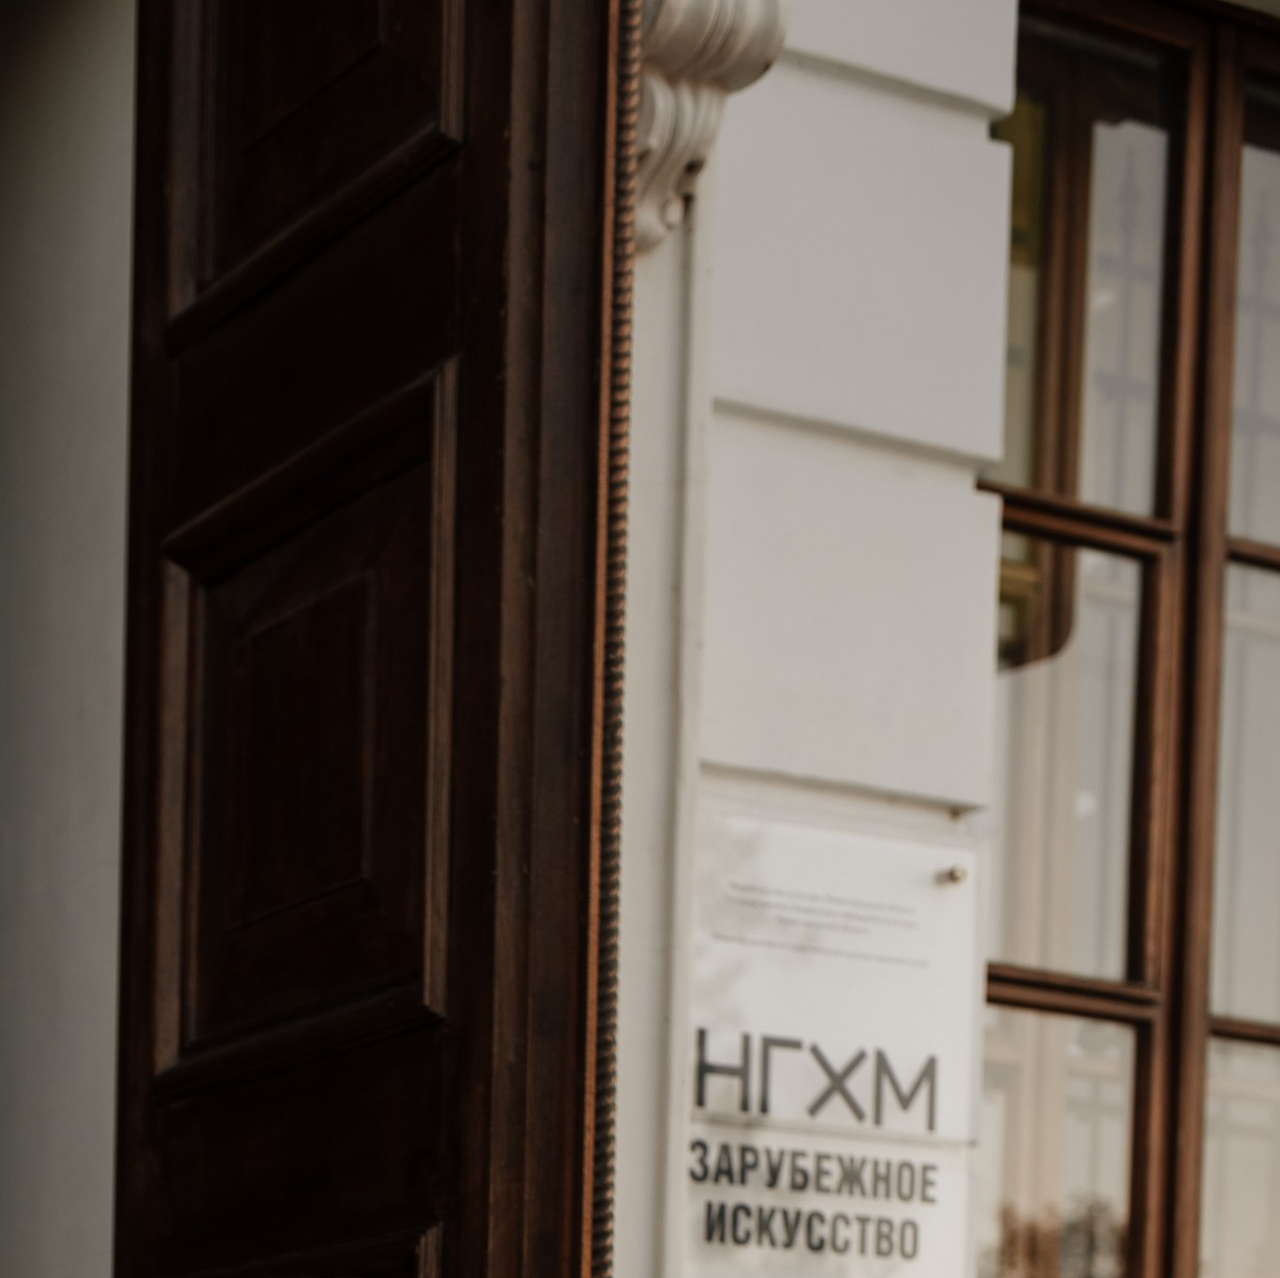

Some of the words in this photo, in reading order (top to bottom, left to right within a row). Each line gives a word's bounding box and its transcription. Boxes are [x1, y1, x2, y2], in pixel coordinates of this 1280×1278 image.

[696, 1027, 937, 1132] НГХМ
[689, 1140, 937, 1204] ЗАРУБЕЖНОЕ
[705, 1202, 919, 1259] ИСКУССТВО
